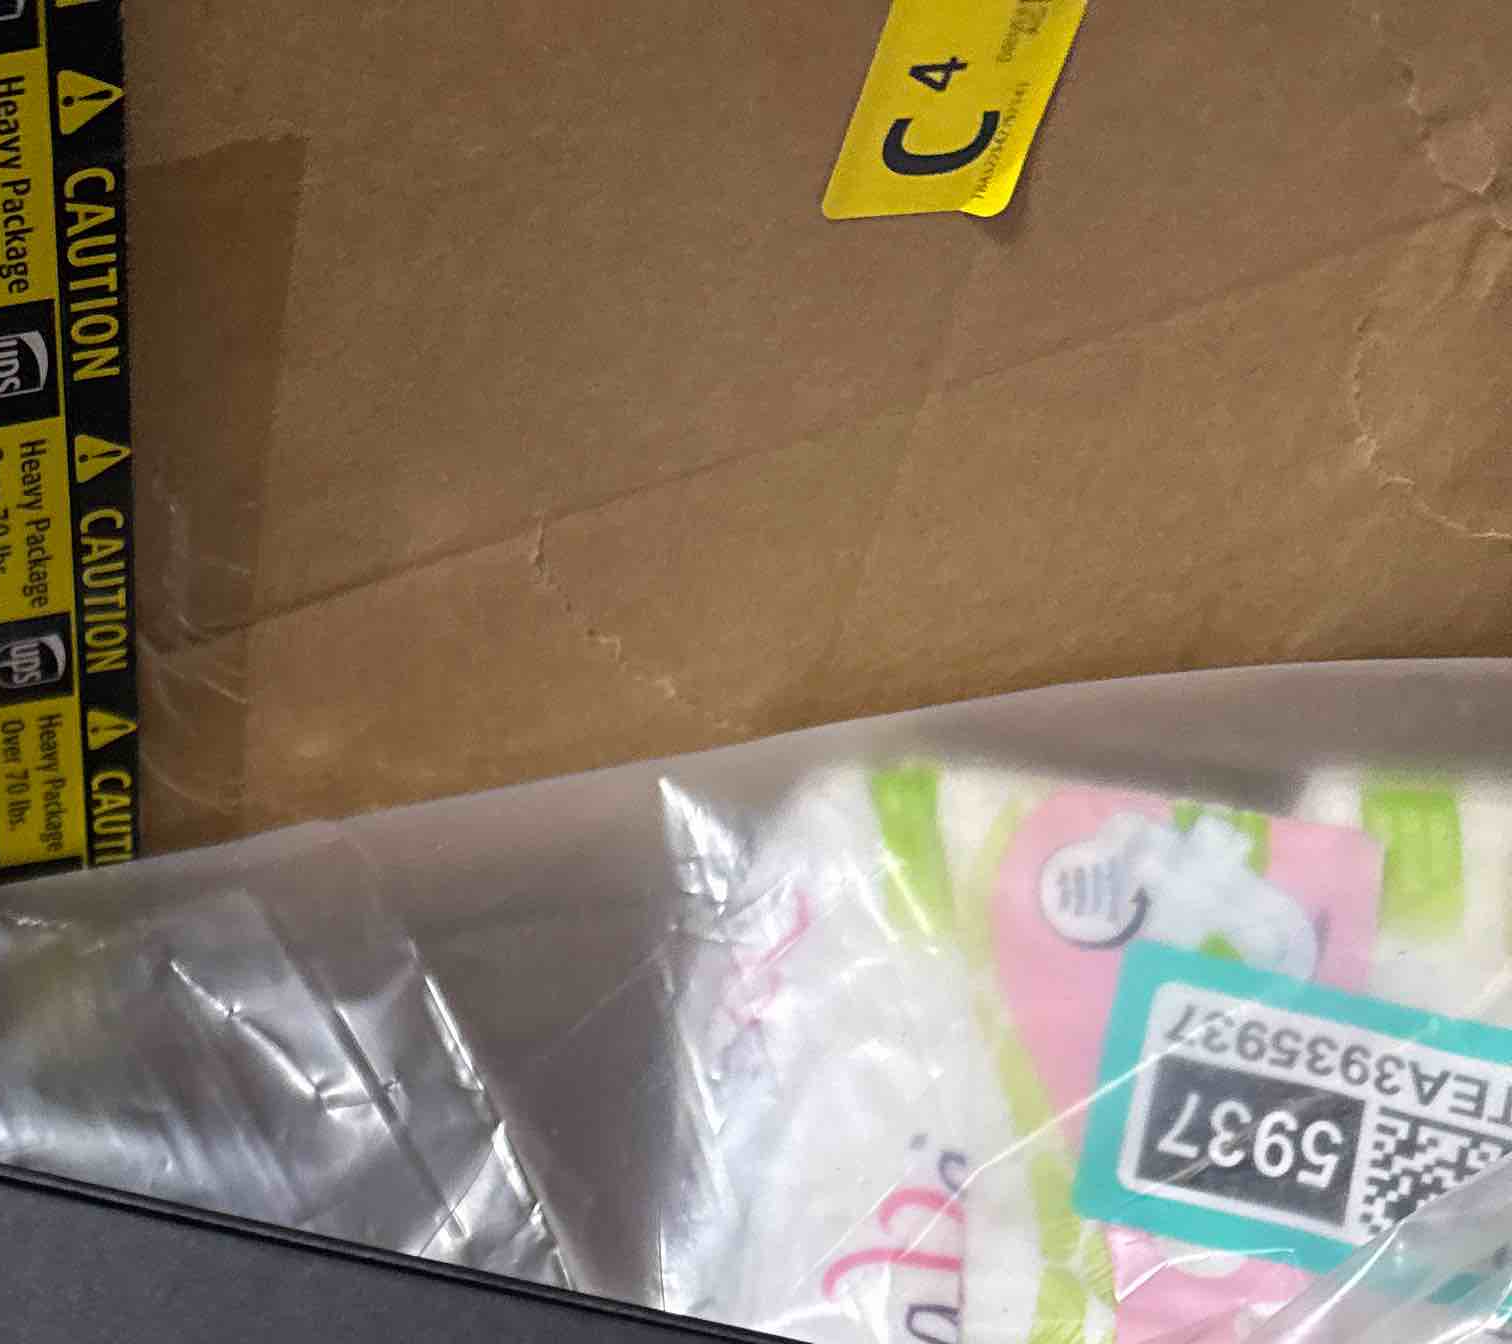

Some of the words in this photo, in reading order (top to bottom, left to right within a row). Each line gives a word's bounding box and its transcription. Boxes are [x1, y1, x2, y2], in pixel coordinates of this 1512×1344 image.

[908, 57, 968, 92] 4
[882, 110, 1000, 176] C
[0, 180, 33, 296] Package
[64, 167, 121, 382] CAUTION
[1156, 1101, 1345, 1188] 5937
